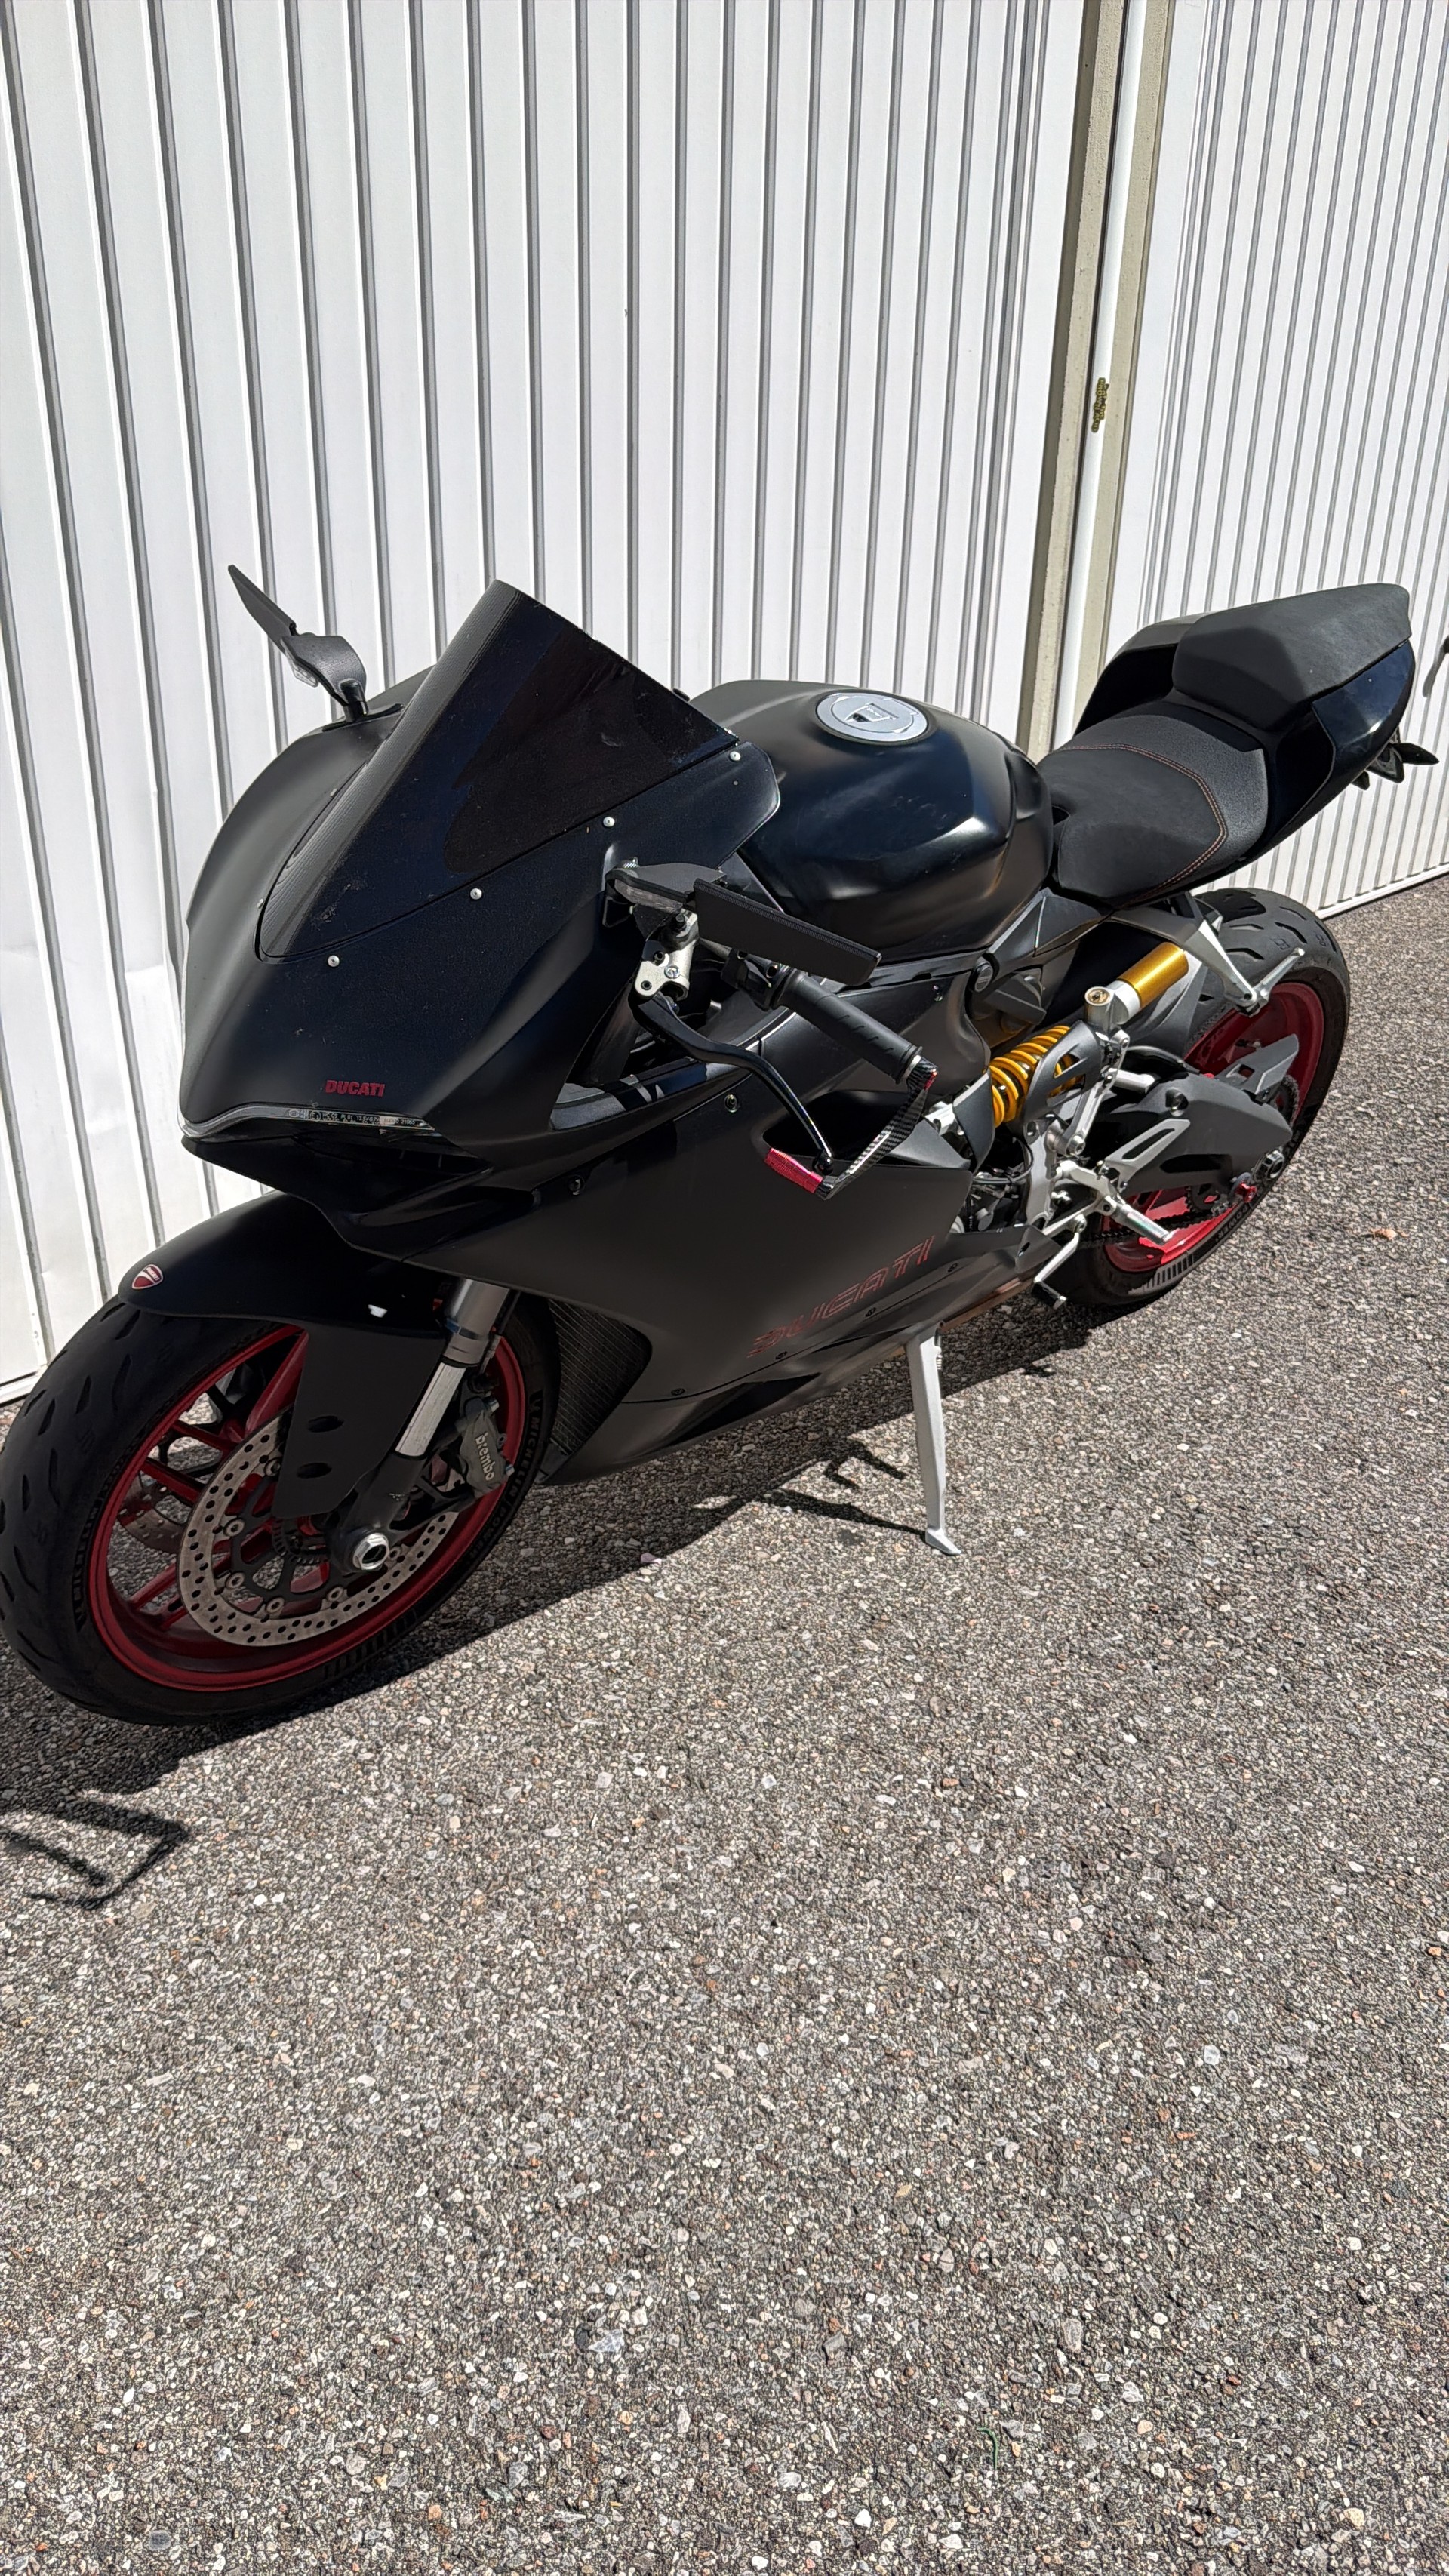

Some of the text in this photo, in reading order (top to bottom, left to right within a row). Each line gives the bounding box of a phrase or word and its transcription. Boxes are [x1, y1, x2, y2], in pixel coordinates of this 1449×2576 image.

[325, 1079, 386, 1097] DUCATI
[746, 1234, 935, 1359] DUCATI
[475, 1431, 497, 1482] brembo
[508, 1415, 541, 1499] MICHELIN
